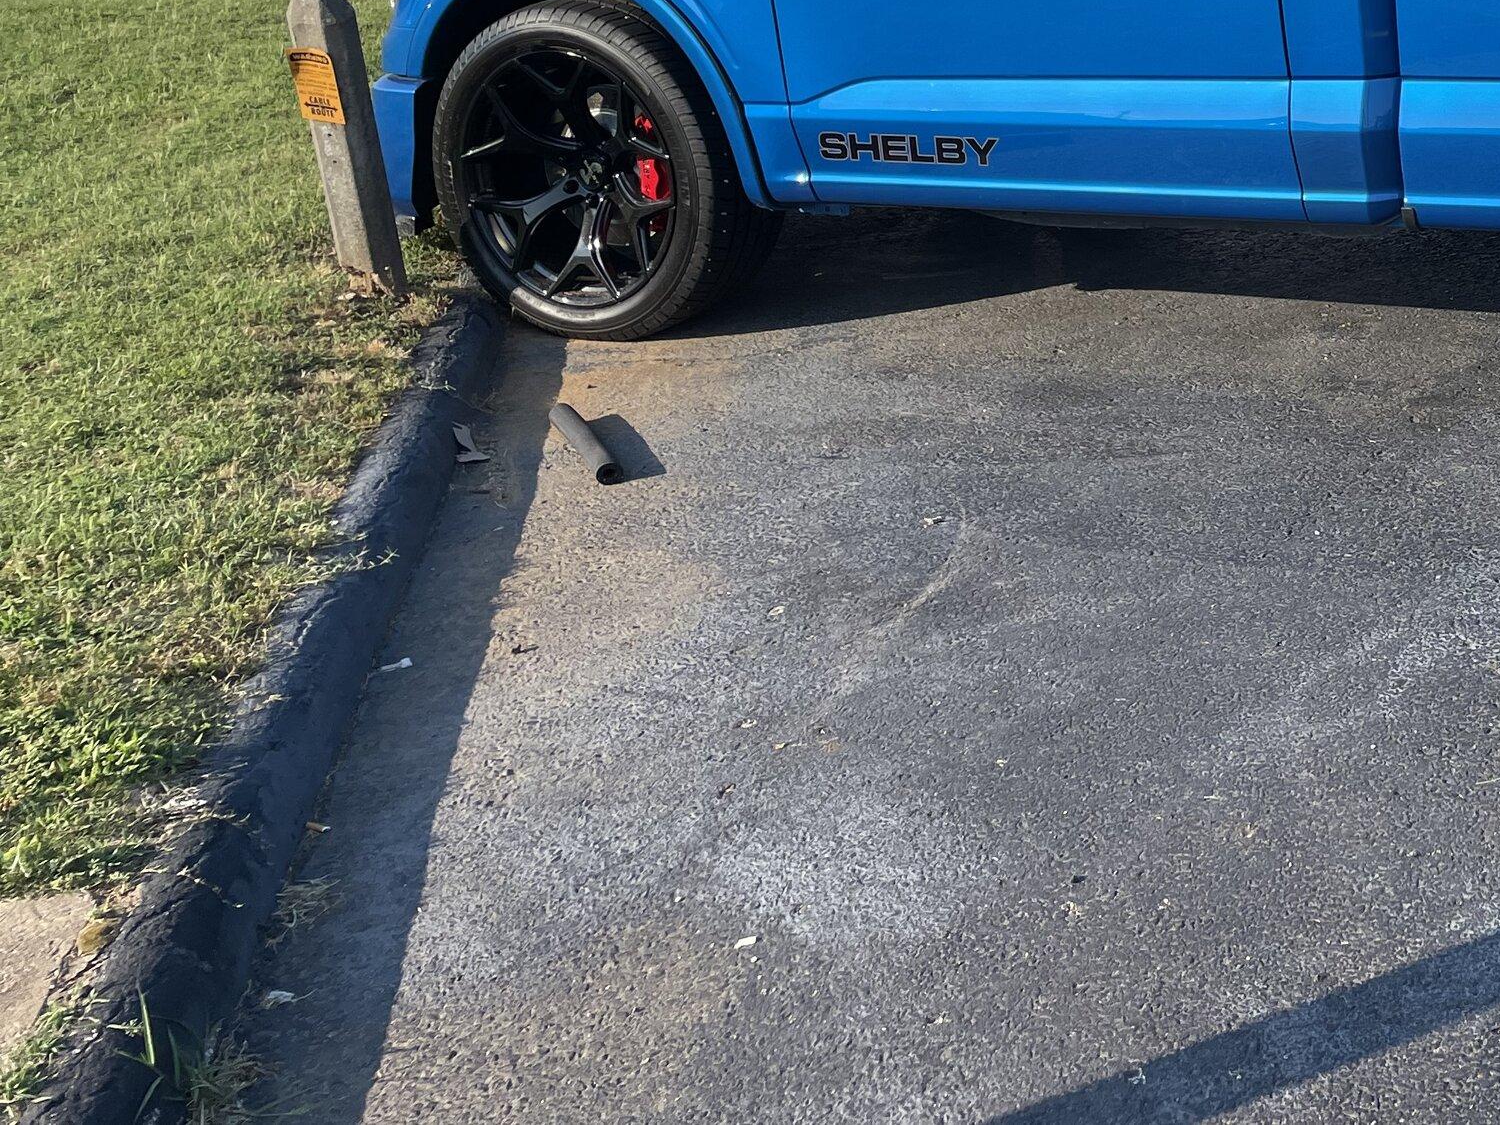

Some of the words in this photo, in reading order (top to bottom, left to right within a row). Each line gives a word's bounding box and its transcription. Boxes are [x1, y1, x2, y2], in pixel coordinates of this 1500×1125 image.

[309, 96, 331, 107] CABLE
[311, 108, 335, 118] ROUTE
[818, 131, 1000, 166] SHELBY
